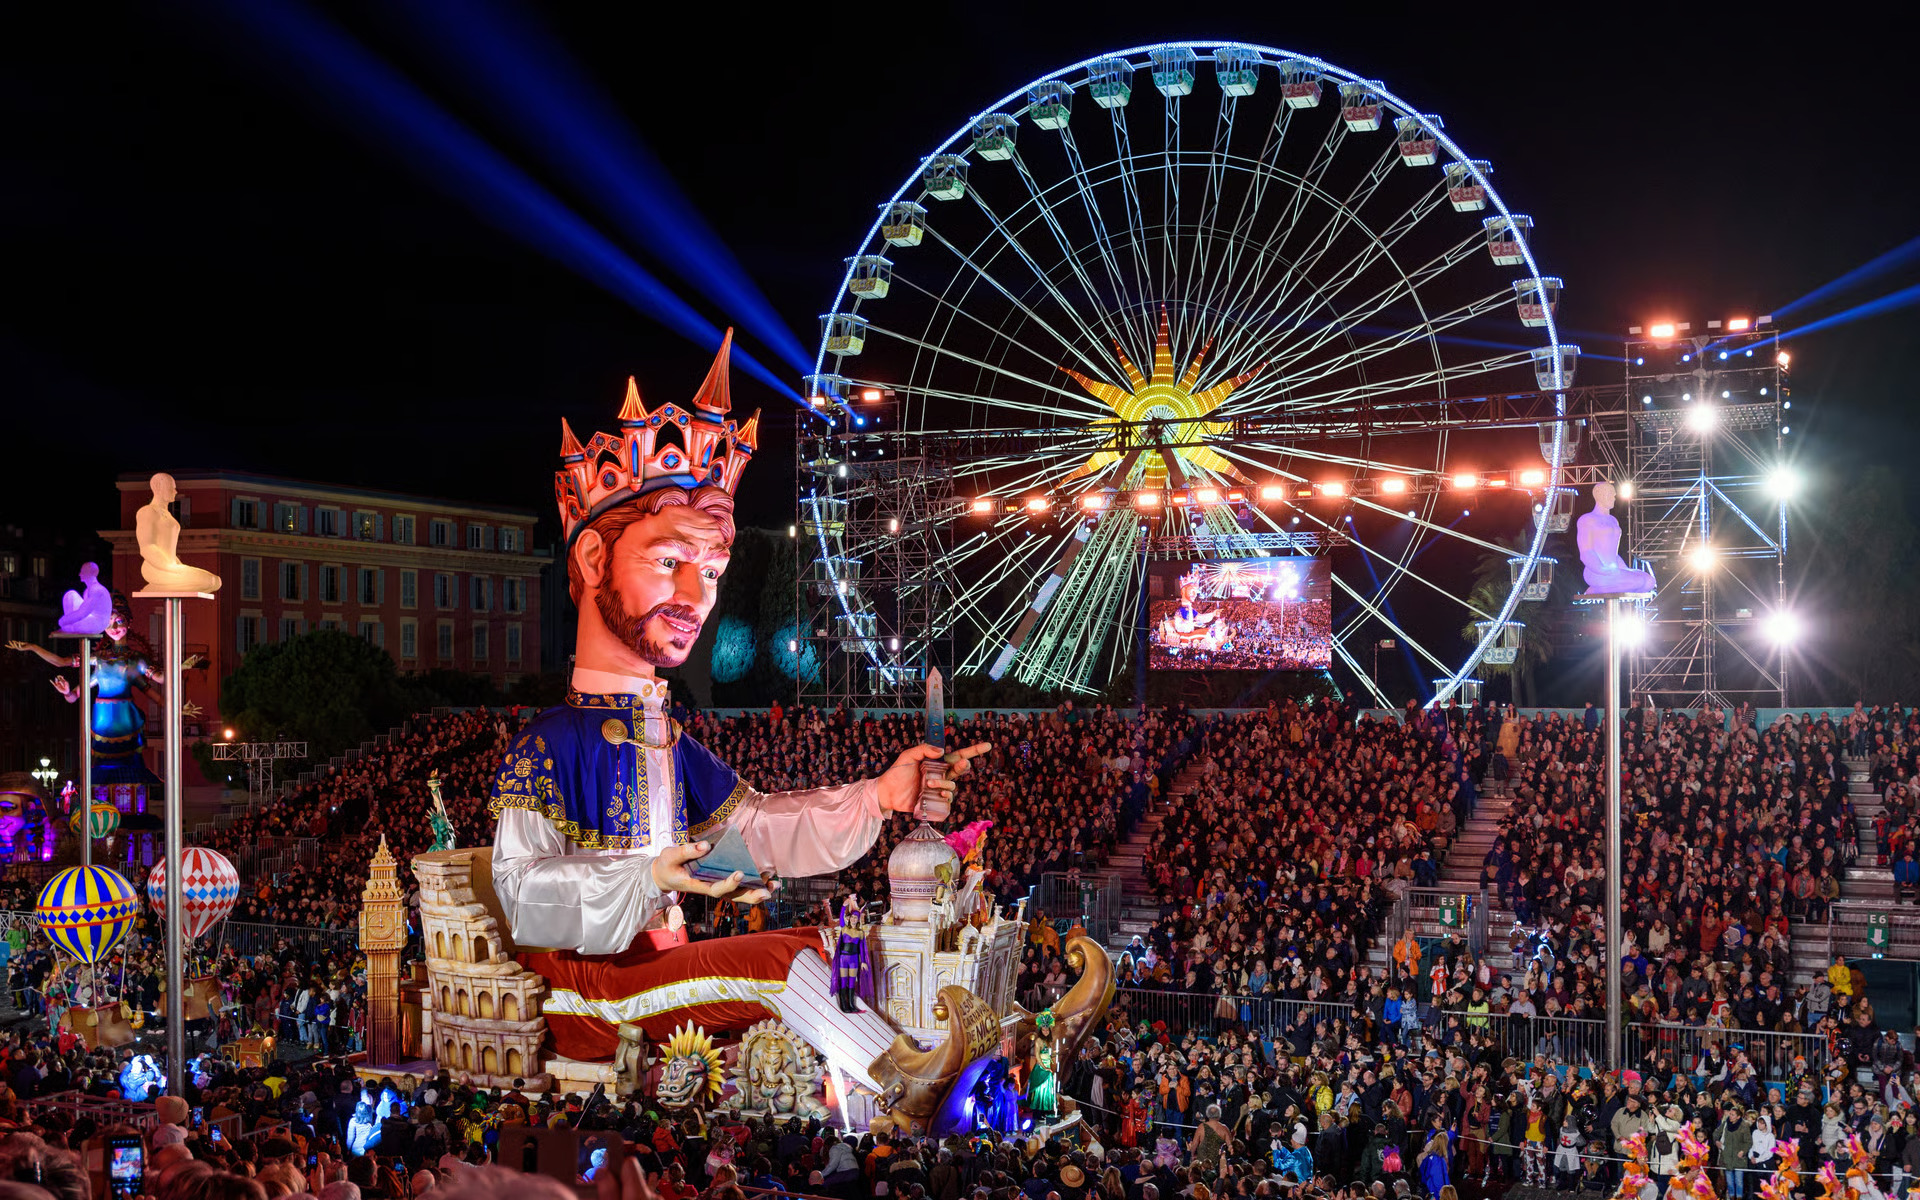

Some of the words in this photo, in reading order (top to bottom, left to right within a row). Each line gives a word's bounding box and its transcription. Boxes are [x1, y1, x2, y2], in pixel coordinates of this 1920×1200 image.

[966, 1029, 976, 1045] DE
[976, 1013, 996, 1043] NICE
[970, 1031, 998, 1063] 2023
